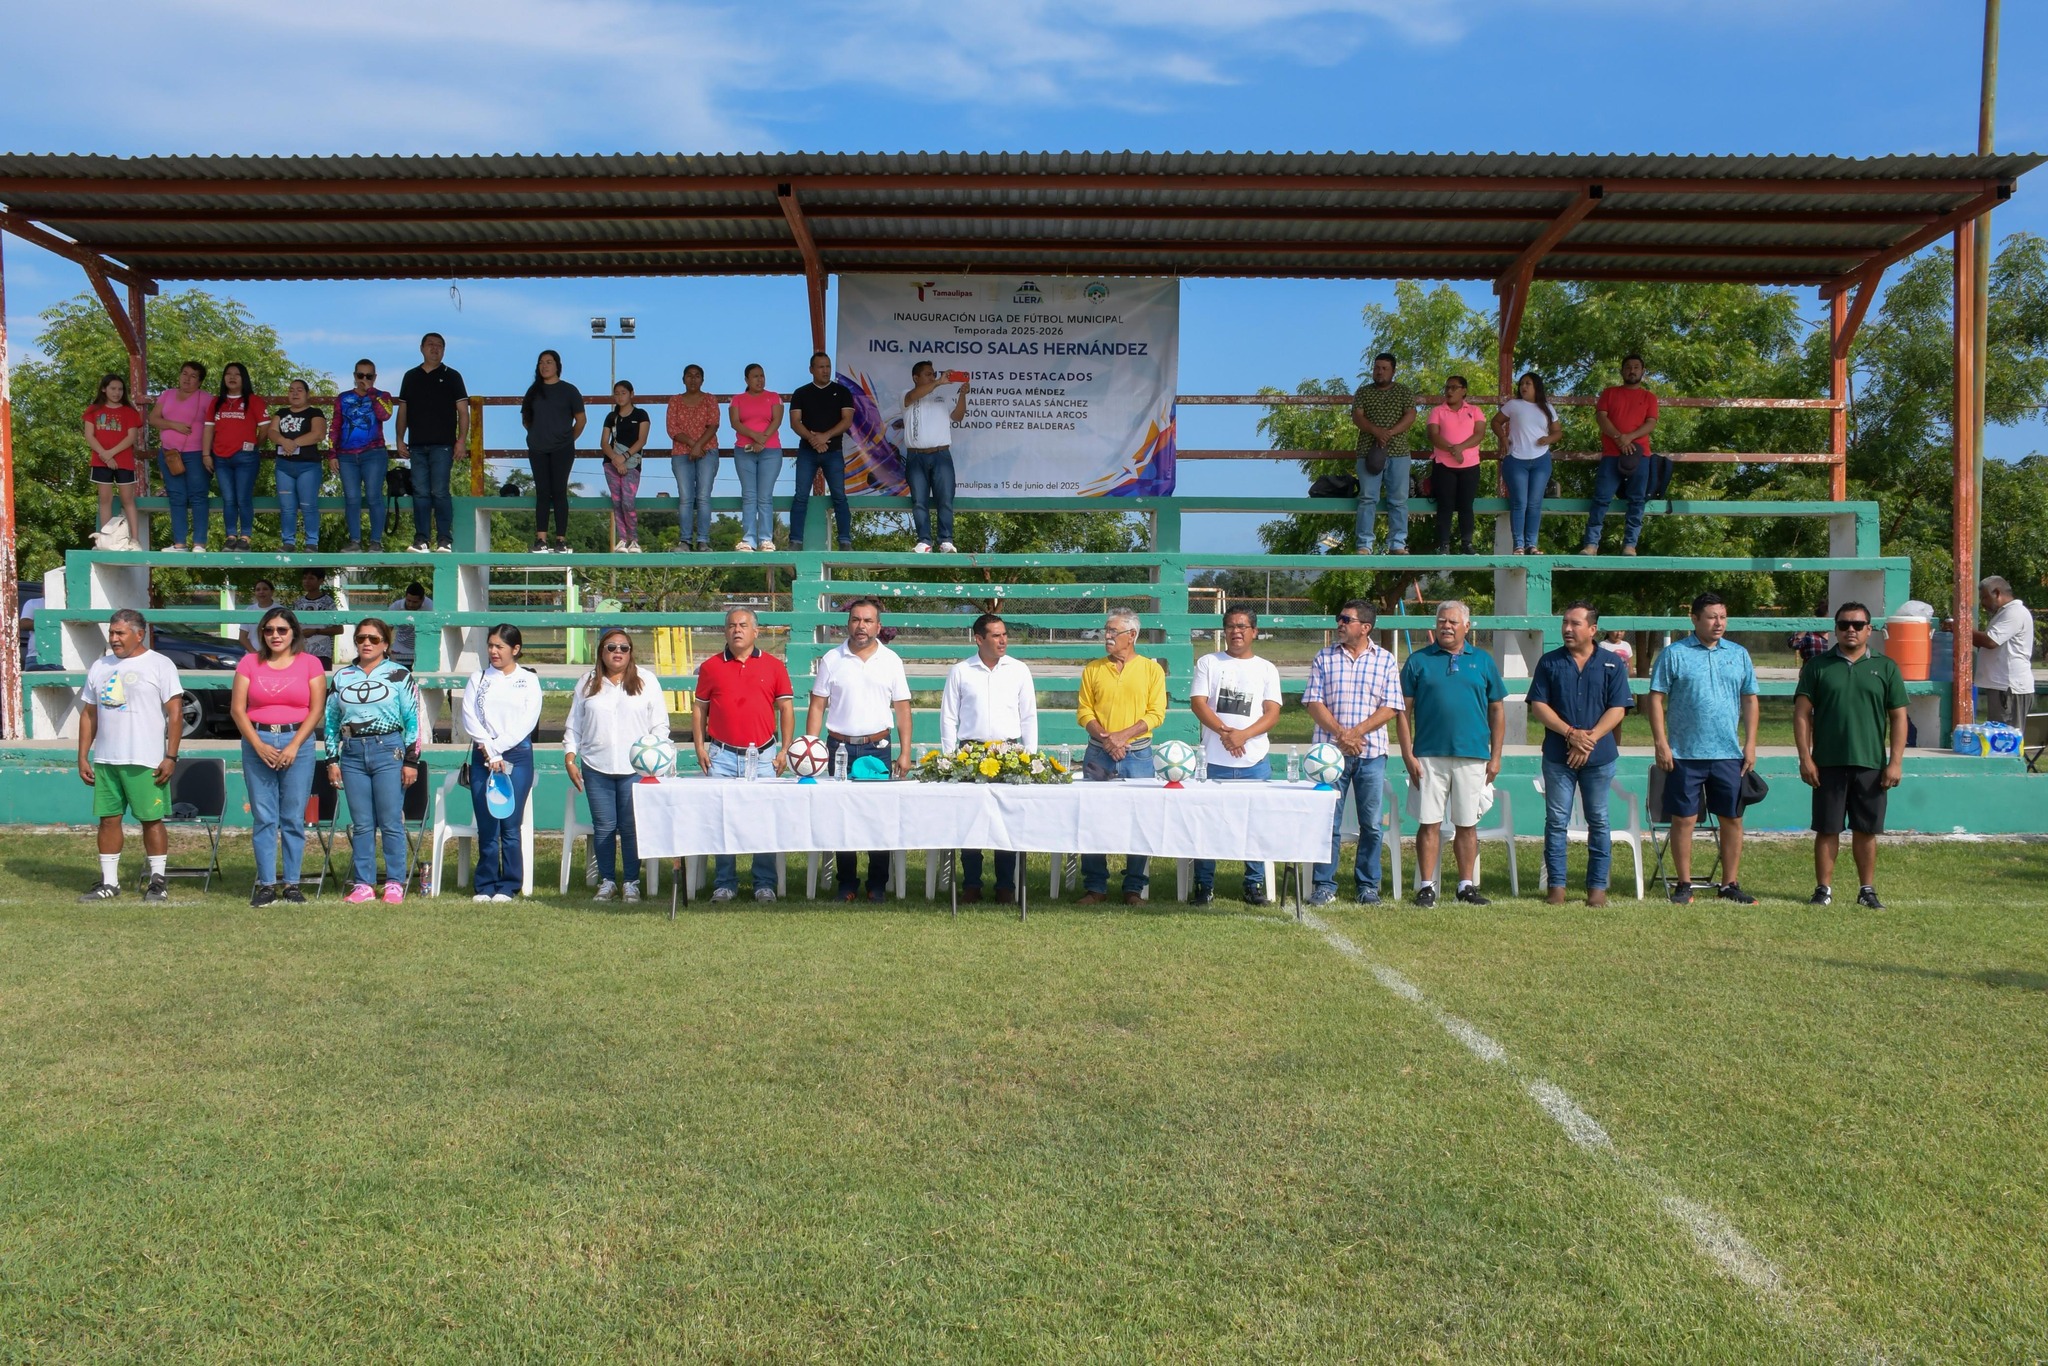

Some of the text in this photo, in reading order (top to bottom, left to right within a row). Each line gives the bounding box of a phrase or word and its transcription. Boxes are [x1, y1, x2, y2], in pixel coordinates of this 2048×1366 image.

[932, 289, 973, 298] Tamaulipas
[1013, 296, 1045, 304] LLERA
[893, 311, 1124, 324] INAUGURACIÓN LIGA DE FÚTBOL MUNICIPAL
[953, 325, 1064, 336] Temporada 2025-2026
[869, 339, 1148, 356] ING. NARCISO SALAS HERNÁNDEZ
[1009, 372, 1093, 382] DESTACADOS
[1025, 387, 1065, 396] MÉNDEZ
[968, 399, 1010, 407] ALBERTO
[1012, 400, 1042, 408] SALAS
[1044, 399, 1089, 408] SÁNCHEZ
[990, 410, 1053, 419] QUINTANILLA
[1056, 411, 1088, 419] ARCOS
[995, 420, 1024, 430] PÉREZ
[1027, 423, 1075, 431] BALDERAS
[1024, 482, 1043, 491] junio
